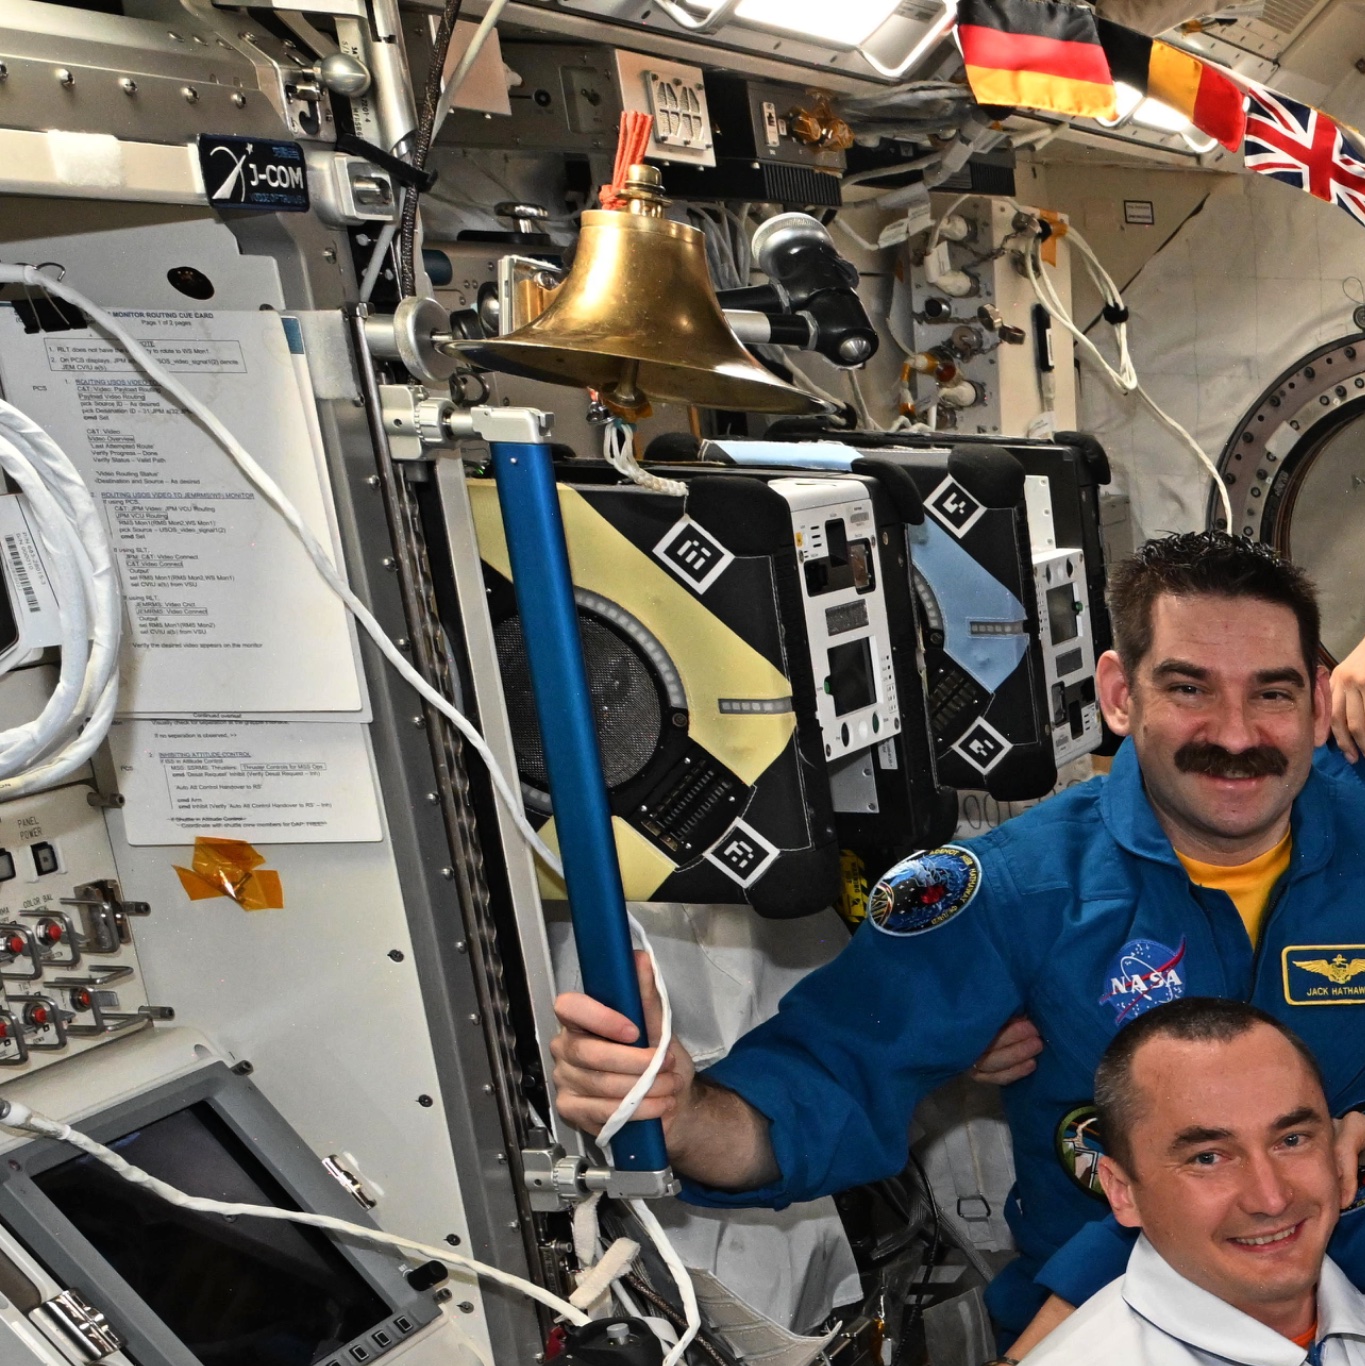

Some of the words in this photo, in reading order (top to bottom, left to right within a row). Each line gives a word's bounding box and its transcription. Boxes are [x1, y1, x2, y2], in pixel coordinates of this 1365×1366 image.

[249, 163, 304, 189] J-COM
[113, 311, 145, 319] MONITOR
[145, 311, 178, 319] ROUTING
[17, 815, 40, 829] PANEL
[20, 827, 43, 840] POWER
[22, 895, 42, 909] COLOR
[1110, 967, 1184, 996] NASA
[1306, 986, 1330, 997] JACK
